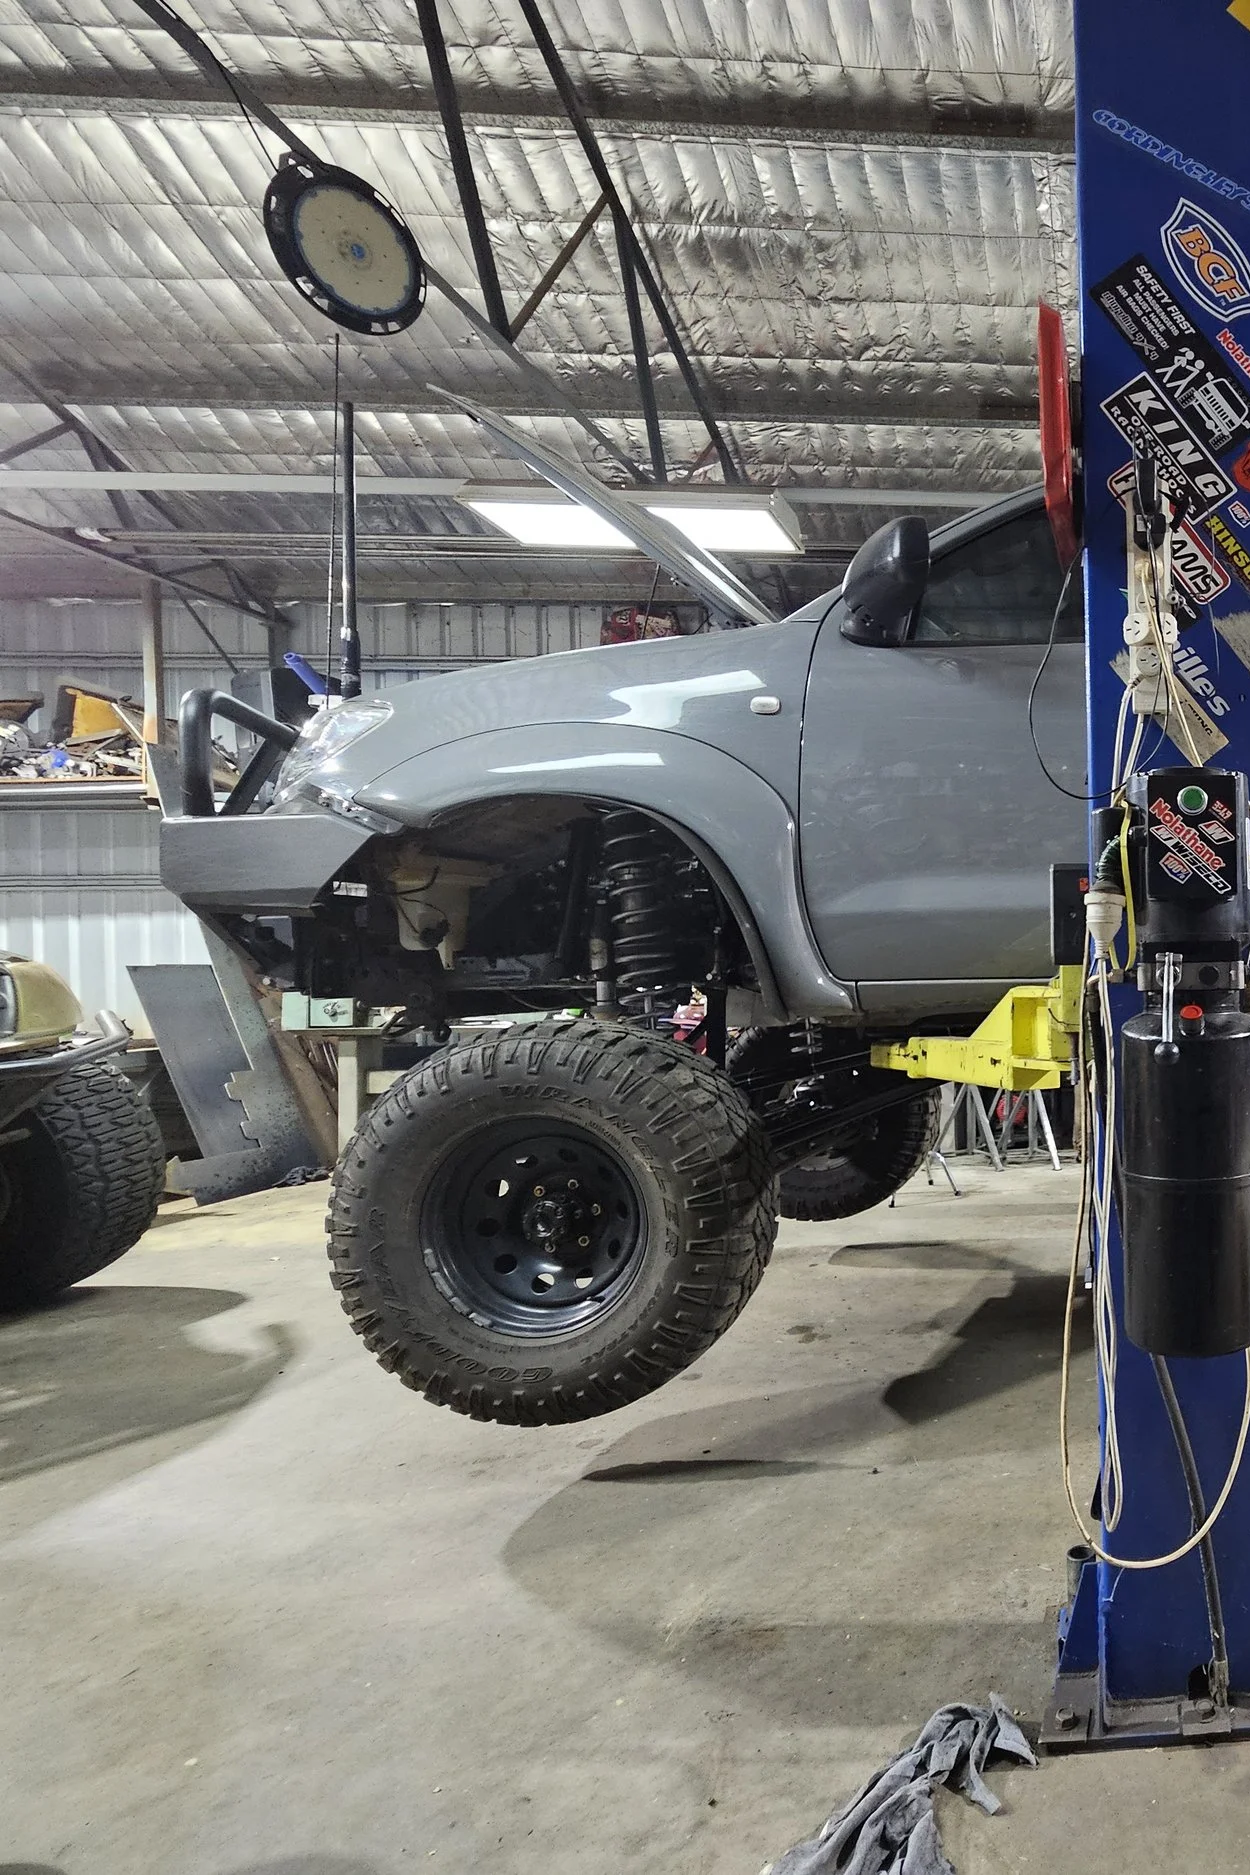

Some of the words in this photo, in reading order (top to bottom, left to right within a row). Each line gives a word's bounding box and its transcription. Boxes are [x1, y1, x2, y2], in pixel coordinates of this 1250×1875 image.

[1172, 224, 1246, 302] BCF
[1116, 284, 1128, 298] AIR
[1125, 296, 1143, 316] BAGS
[1140, 315, 1169, 350] CHECKED!
[1132, 278, 1144, 292] ALL
[1142, 290, 1179, 336] PASSENGERS
[1133, 292, 1151, 312] MUST
[1149, 311, 1166, 332] HAVE
[1135, 265, 1172, 303] SAFETY
[1166, 304, 1196, 334] FIRST
[1128, 389, 1226, 498] KING
[1130, 415, 1187, 485] OFF-ROAD
[1172, 639, 1231, 717] illes
[1149, 798, 1226, 871] Nolathane
[1164, 856, 1190, 880] 100%
